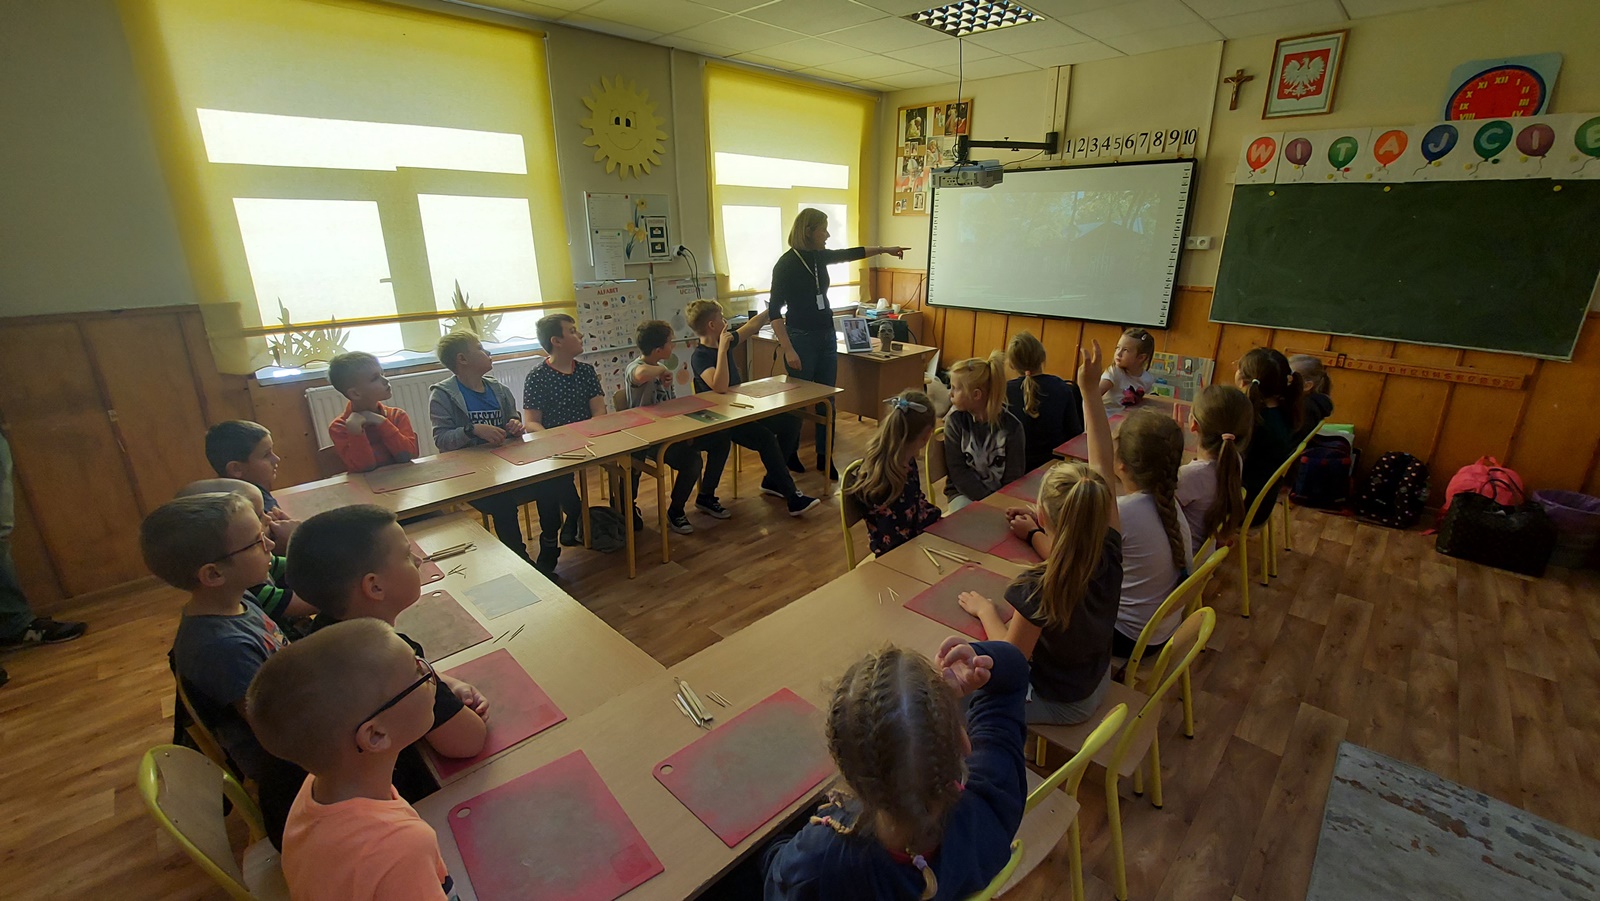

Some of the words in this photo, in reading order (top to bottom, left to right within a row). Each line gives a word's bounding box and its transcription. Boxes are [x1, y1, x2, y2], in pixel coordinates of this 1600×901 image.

[1494, 76, 1509, 84] XII
[1478, 81, 1488, 89] XI
[1522, 86, 1530, 94] II
[1518, 98, 1530, 106] III
[1065, 139, 1071, 153] 1
[1077, 138, 1085, 152] 2
[1090, 138, 1098, 152] 3
[1101, 136, 1111, 150] 4
[1114, 137, 1121, 149] 5
[1125, 133, 1135, 148] 6
[1139, 132, 1148, 147] 7
[1153, 131, 1163, 146] 8
[1168, 129, 1180, 145] 9
[1183, 128, 1197, 145] 10
[597, 287, 619, 296] ALFABET
